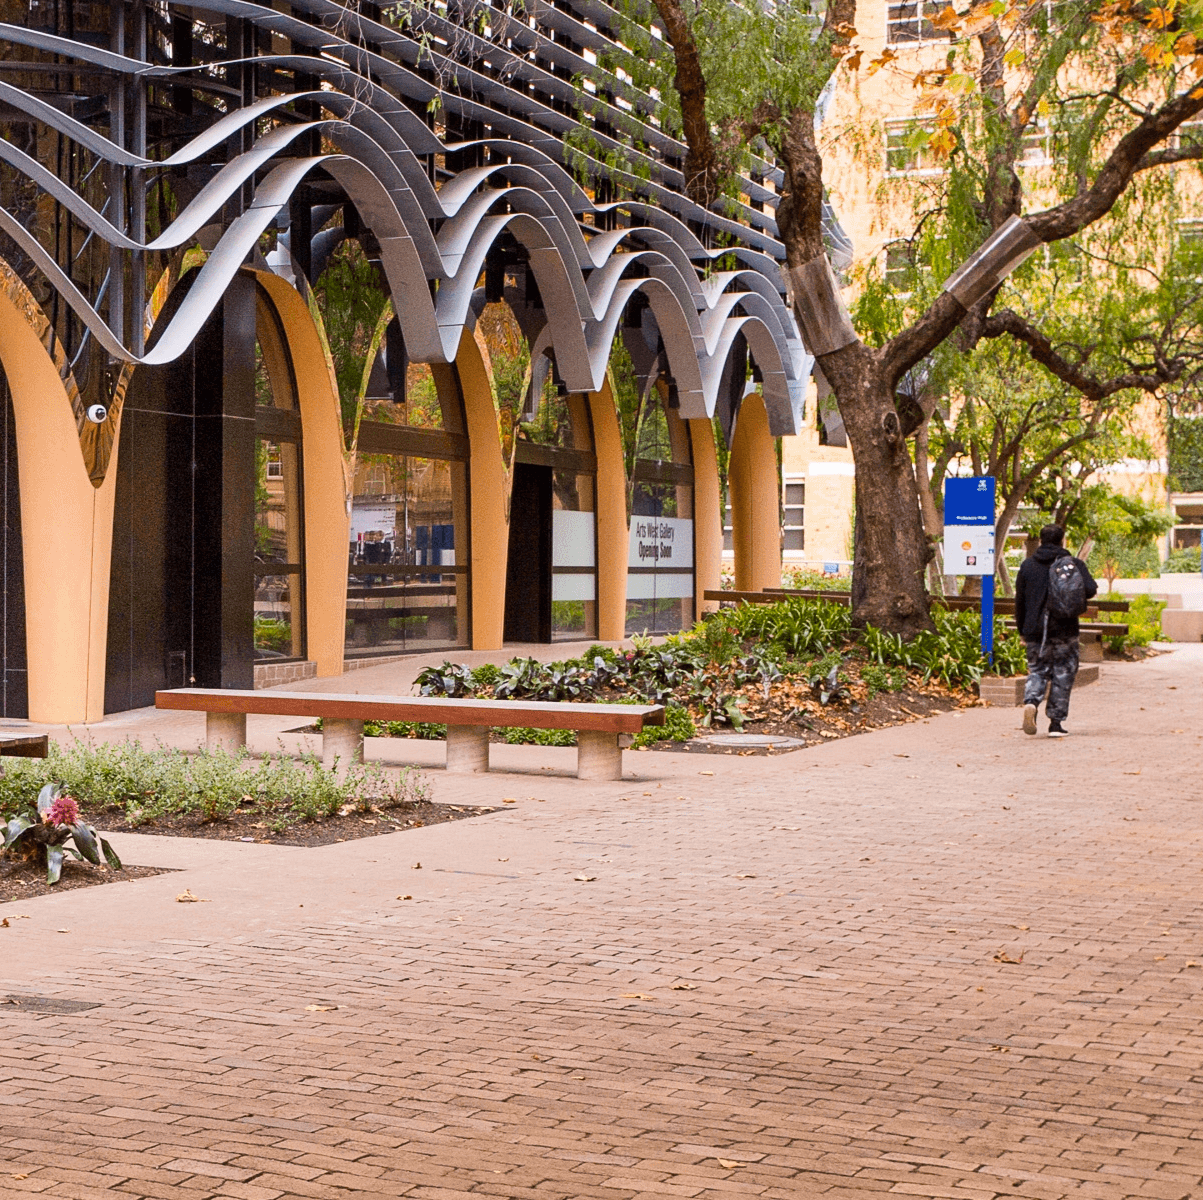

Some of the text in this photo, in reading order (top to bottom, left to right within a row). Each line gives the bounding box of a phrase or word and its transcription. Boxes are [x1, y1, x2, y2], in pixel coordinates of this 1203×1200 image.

[636, 522, 674, 543] Arts West Gallery
[639, 541, 672, 561] Opening Soon
